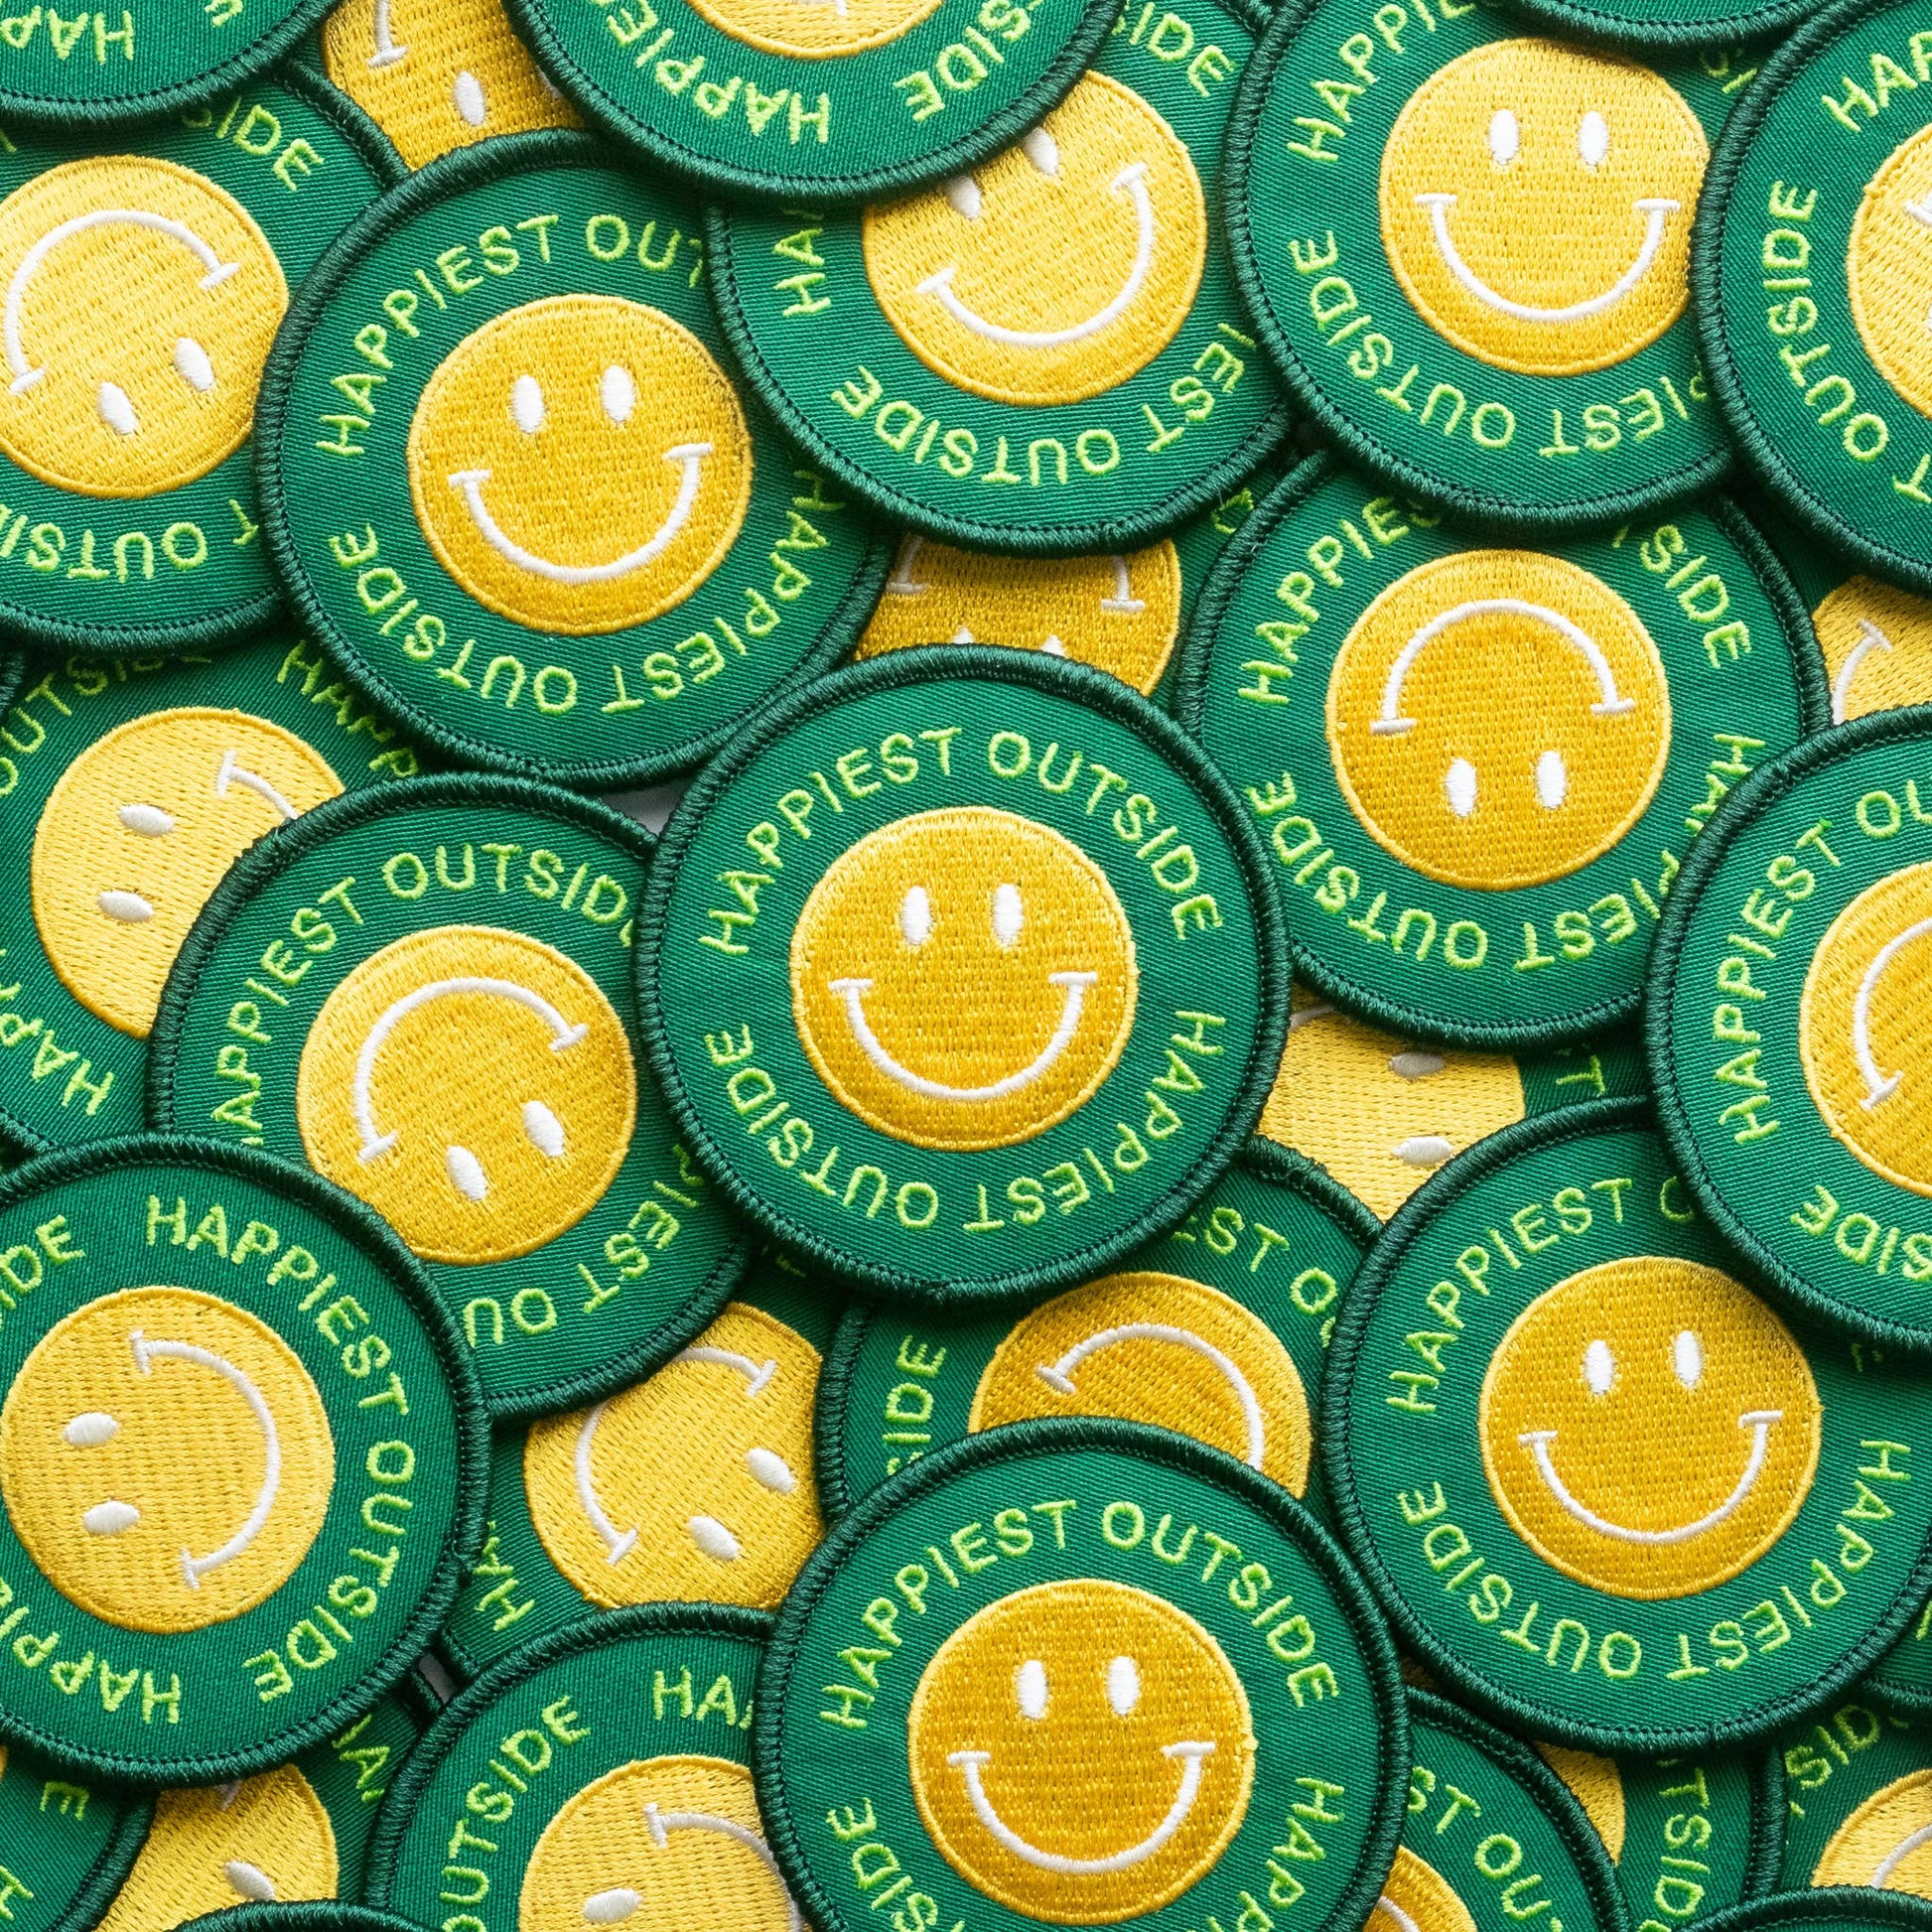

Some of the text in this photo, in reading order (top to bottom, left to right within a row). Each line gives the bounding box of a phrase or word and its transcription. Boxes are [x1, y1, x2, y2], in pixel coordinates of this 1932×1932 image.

[316, 214, 559, 456] HAPPIEST
[831, 365, 1121, 486] OUTSIDE
[1289, 229, 1515, 449] OUTSIDE
[1762, 180, 1888, 463] OUTSIDE
[329, 523, 577, 715] OUTSIDE
[699, 728, 1223, 955] HAPPIEST OUTSIDE
[1245, 771, 1487, 971] OUTSIDE
[1713, 819, 1842, 1146] HAPPIEST
[705, 1024, 939, 1229] OUTSIDE
[963, 1010, 1226, 1233] HAPPIEST
[147, 1195, 411, 1418] HAPPIEST
[1387, 1177, 1632, 1413] HAPPIEST
[242, 1440, 415, 1704] OUTSIDE
[820, 1499, 1339, 1729] HAPPIEST OUTSIDE
[1398, 1481, 1642, 1680] OUTSIDE
[1667, 1440, 1911, 1680] HAPPIEST
